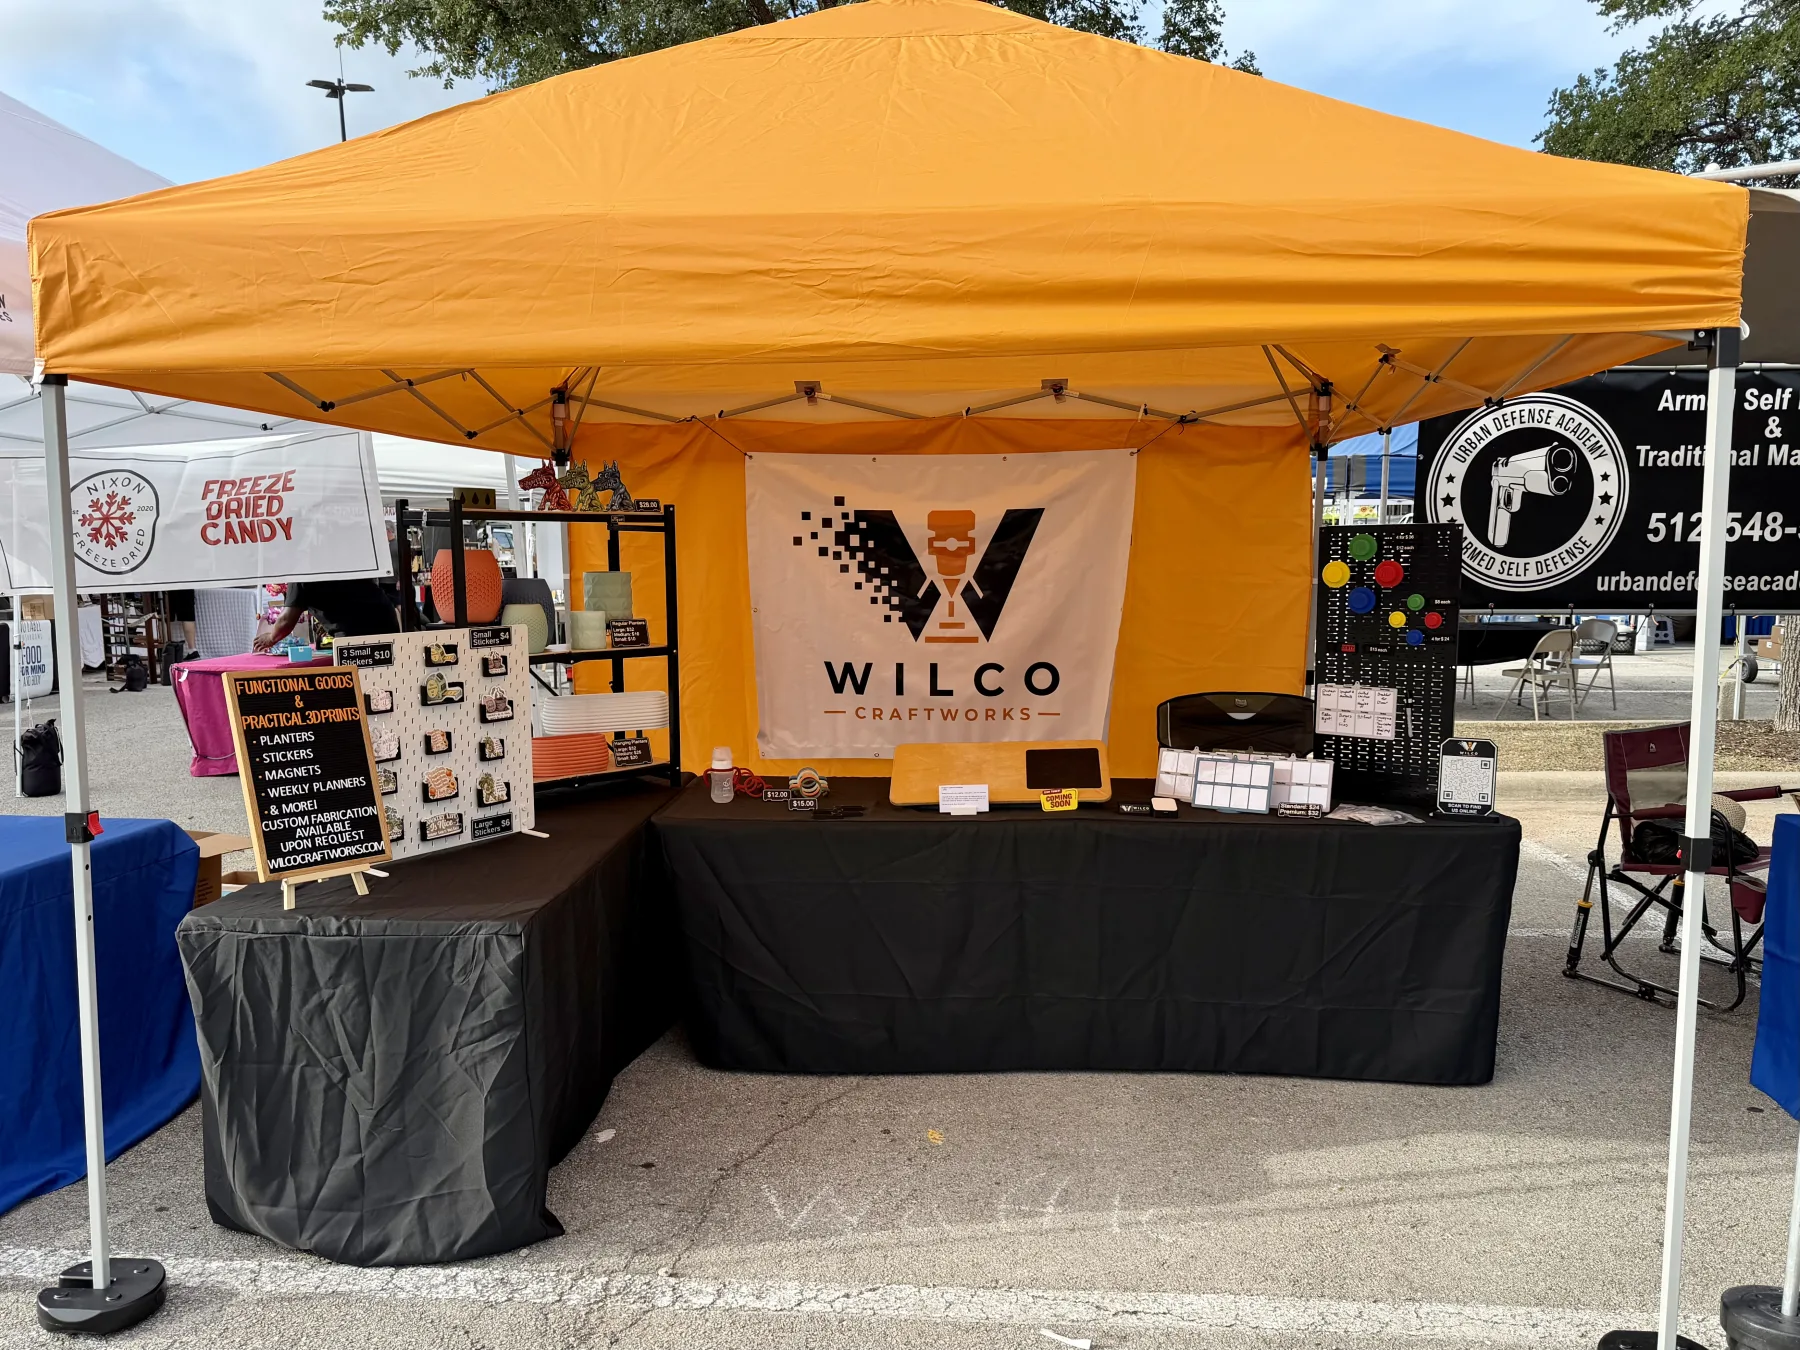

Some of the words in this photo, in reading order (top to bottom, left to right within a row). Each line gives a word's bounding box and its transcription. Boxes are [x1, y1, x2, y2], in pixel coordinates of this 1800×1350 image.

[1657, 389, 1736, 411] Arm
[1743, 388, 1793, 411] Self
[1452, 424, 1493, 464] URBAN
[1492, 408, 1554, 432] DEFENSE
[1555, 413, 1609, 462] ACADEMY
[1764, 416, 1783, 438] &
[1636, 444, 1760, 467] Traditinal
[86, 477, 146, 496] NIXON
[201, 469, 297, 500] FREEZE
[205, 494, 284, 521] DRIED
[201, 516, 293, 546] CANDY
[73, 531, 117, 568] FREEZE
[121, 528, 145, 566] DRIED
[1498, 560, 1530, 577] SELF
[1535, 535, 1593, 576] DEFENSE
[473, 631, 492, 640] Small
[500, 630, 510, 640] $4
[473, 638, 500, 647] Stickers
[341, 657, 373, 666] Stickers
[349, 647, 371, 657] Small
[374, 650, 390, 660] $10
[235, 677, 314, 695] FUNCTIONAL
[315, 675, 353, 690] GOODS
[823, 660, 1061, 697] WILCO
[294, 694, 304, 708] &
[242, 711, 306, 730] PRACTICAL
[855, 706, 1031, 721] CRAFTWORKS
[260, 731, 315, 746] PLANTERS
[262, 748, 314, 764] STICKERS
[264, 764, 322, 781] MAGNETS
[267, 783, 310, 798] WEEKLY
[313, 776, 367, 793] PLANNERS
[792, 800, 814, 808] $15.00
[1046, 793, 1073, 803] COMING
[1050, 800, 1071, 809] SOON
[262, 815, 309, 832] CUSTOM
[311, 805, 378, 824] FABRICATION
[270, 805, 279, 816] &
[295, 820, 352, 839] AVAILABLE
[474, 820, 493, 830] Large
[501, 818, 511, 827] $6
[474, 826, 501, 837] Stickers
[280, 838, 312, 853] UPON
[314, 829, 365, 846] REQUEST
[267, 840, 386, 870] WILCOCRAFTWORKS.COM
